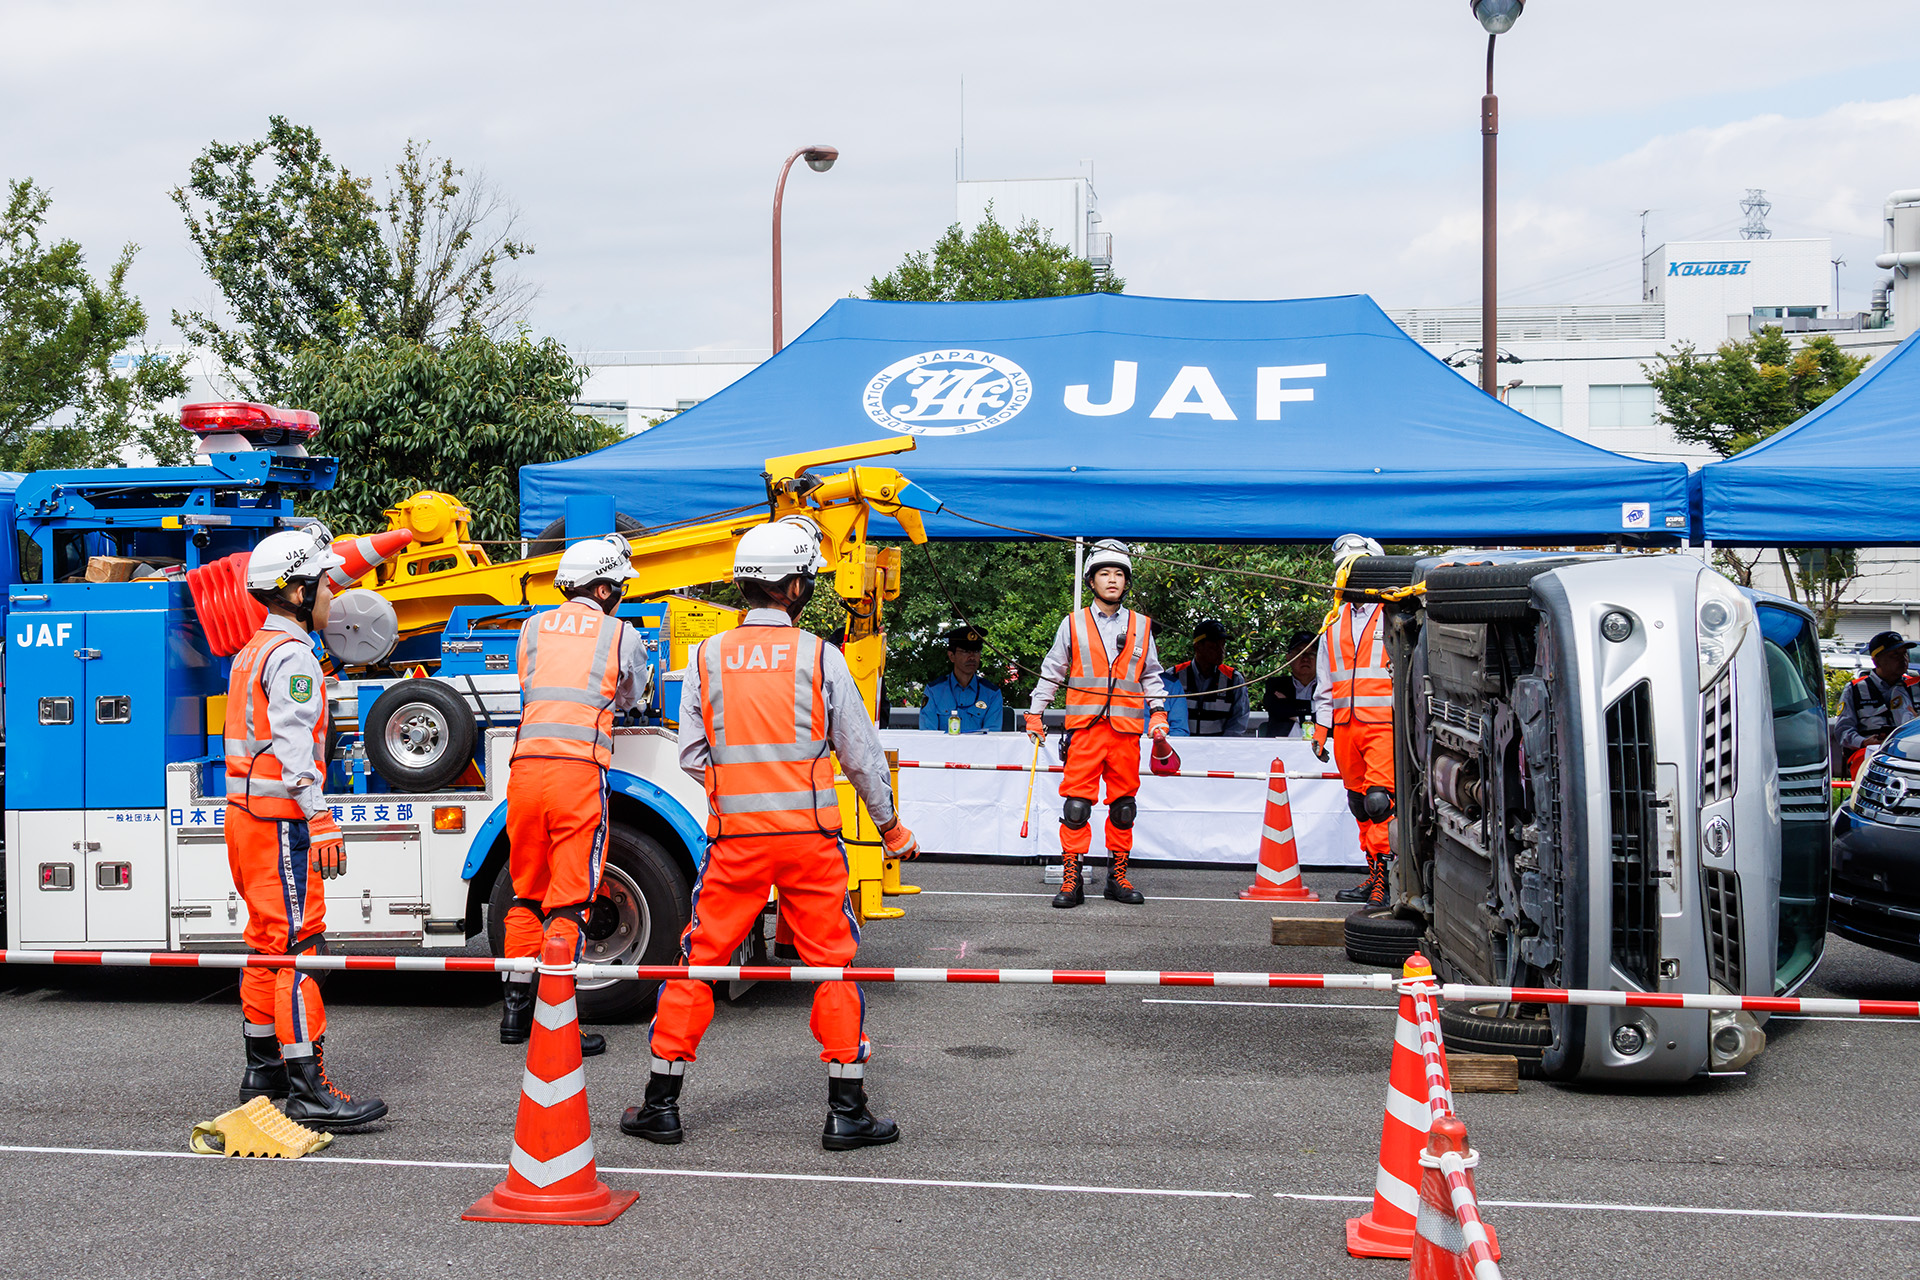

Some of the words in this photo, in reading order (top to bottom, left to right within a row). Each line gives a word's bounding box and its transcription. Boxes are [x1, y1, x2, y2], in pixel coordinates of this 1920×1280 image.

[1667, 260, 1751, 276] Kokusai
[916, 351, 996, 365] JAPAN
[1063, 360, 1327, 421] JAF
[867, 373, 927, 434] FEDERATION
[954, 371, 1029, 434] AUTOMOBILE
[285, 549, 305, 561] JAF
[794, 544, 809, 555] JAF
[281, 554, 309, 580] uvex
[595, 560, 618, 576] uvex
[599, 556, 614, 565] JAF
[734, 565, 763, 573] uvex
[543, 613, 598, 634] JAF
[17, 623, 72, 648] JAF
[726, 643, 791, 670] JAF
